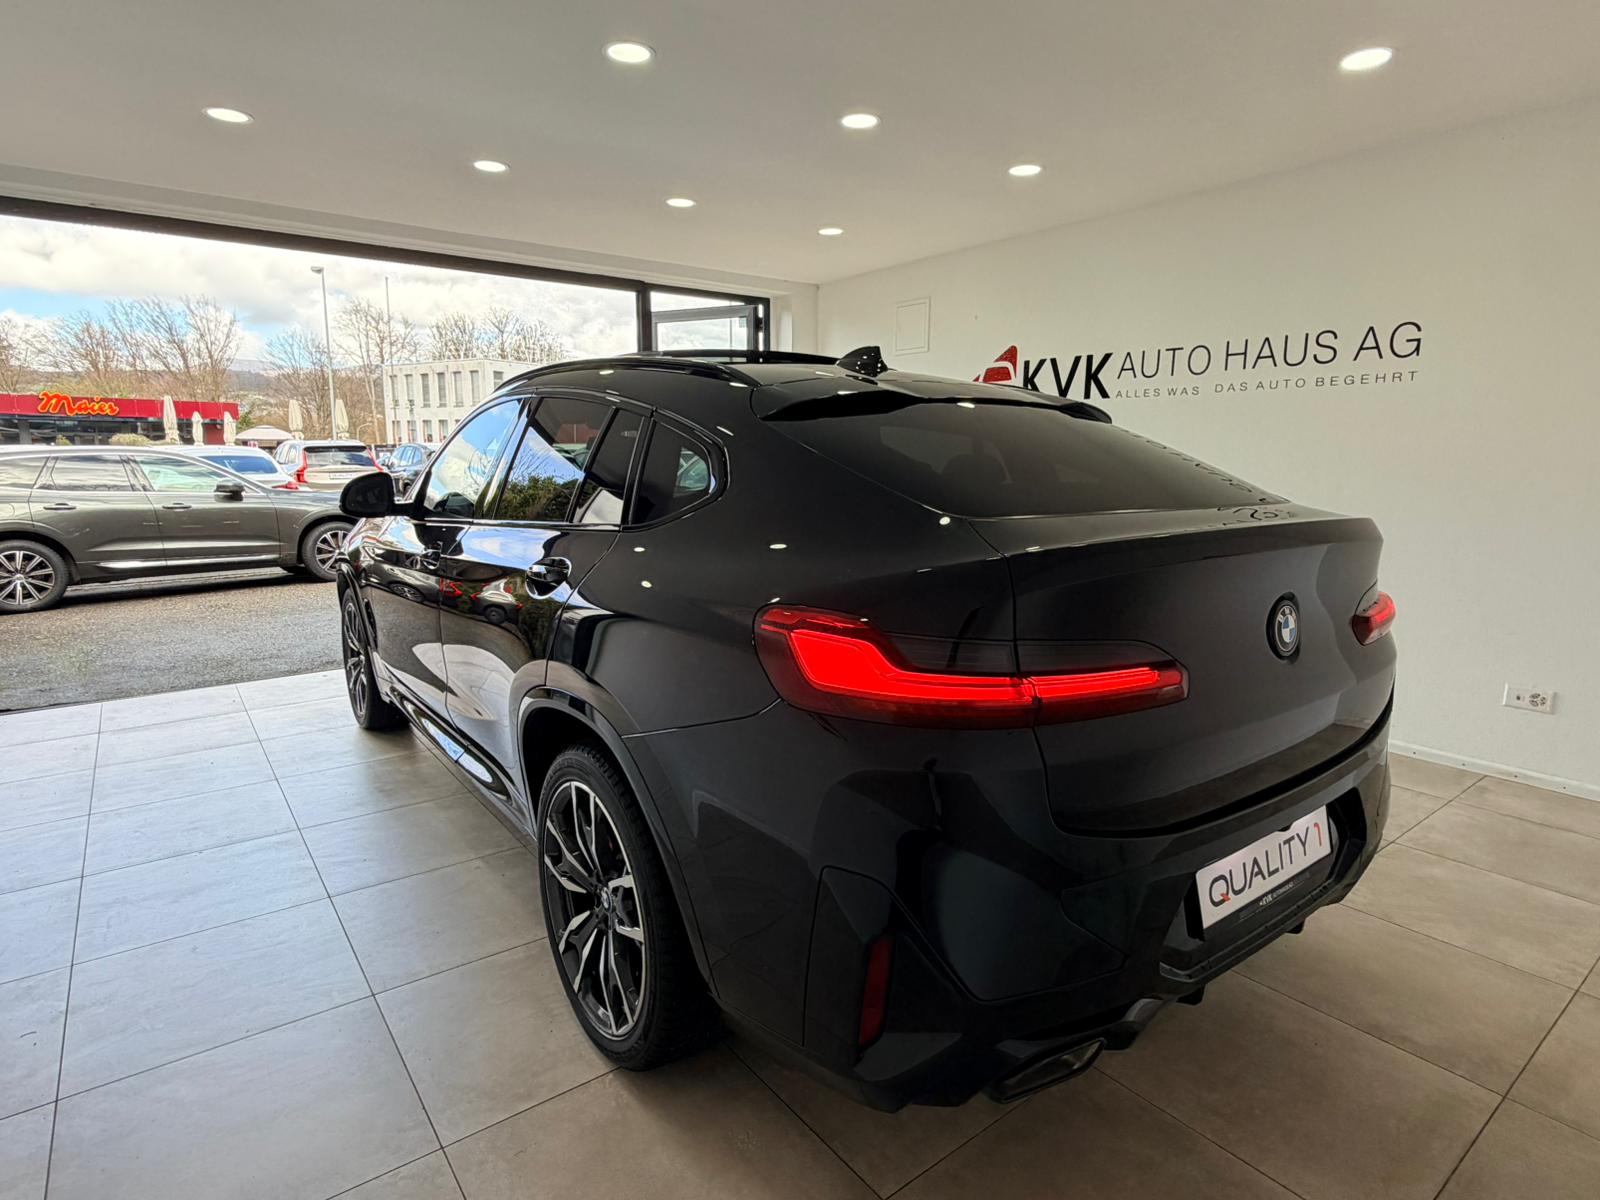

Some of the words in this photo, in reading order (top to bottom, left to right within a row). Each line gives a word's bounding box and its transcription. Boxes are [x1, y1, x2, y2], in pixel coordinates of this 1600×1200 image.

[1023, 352, 1113, 399] KVK
[1117, 345, 1211, 379] AUTO
[1225, 330, 1338, 371] HAUS
[1353, 321, 1422, 361] AG
[1116, 388, 1161, 398] ALLES
[1167, 386, 1200, 396] WAS
[1215, 381, 1248, 393] DAS
[1256, 378, 1306, 390] AUTO
[1315, 371, 1418, 387] BEGEHRT
[38, 391, 119, 416] Maier
